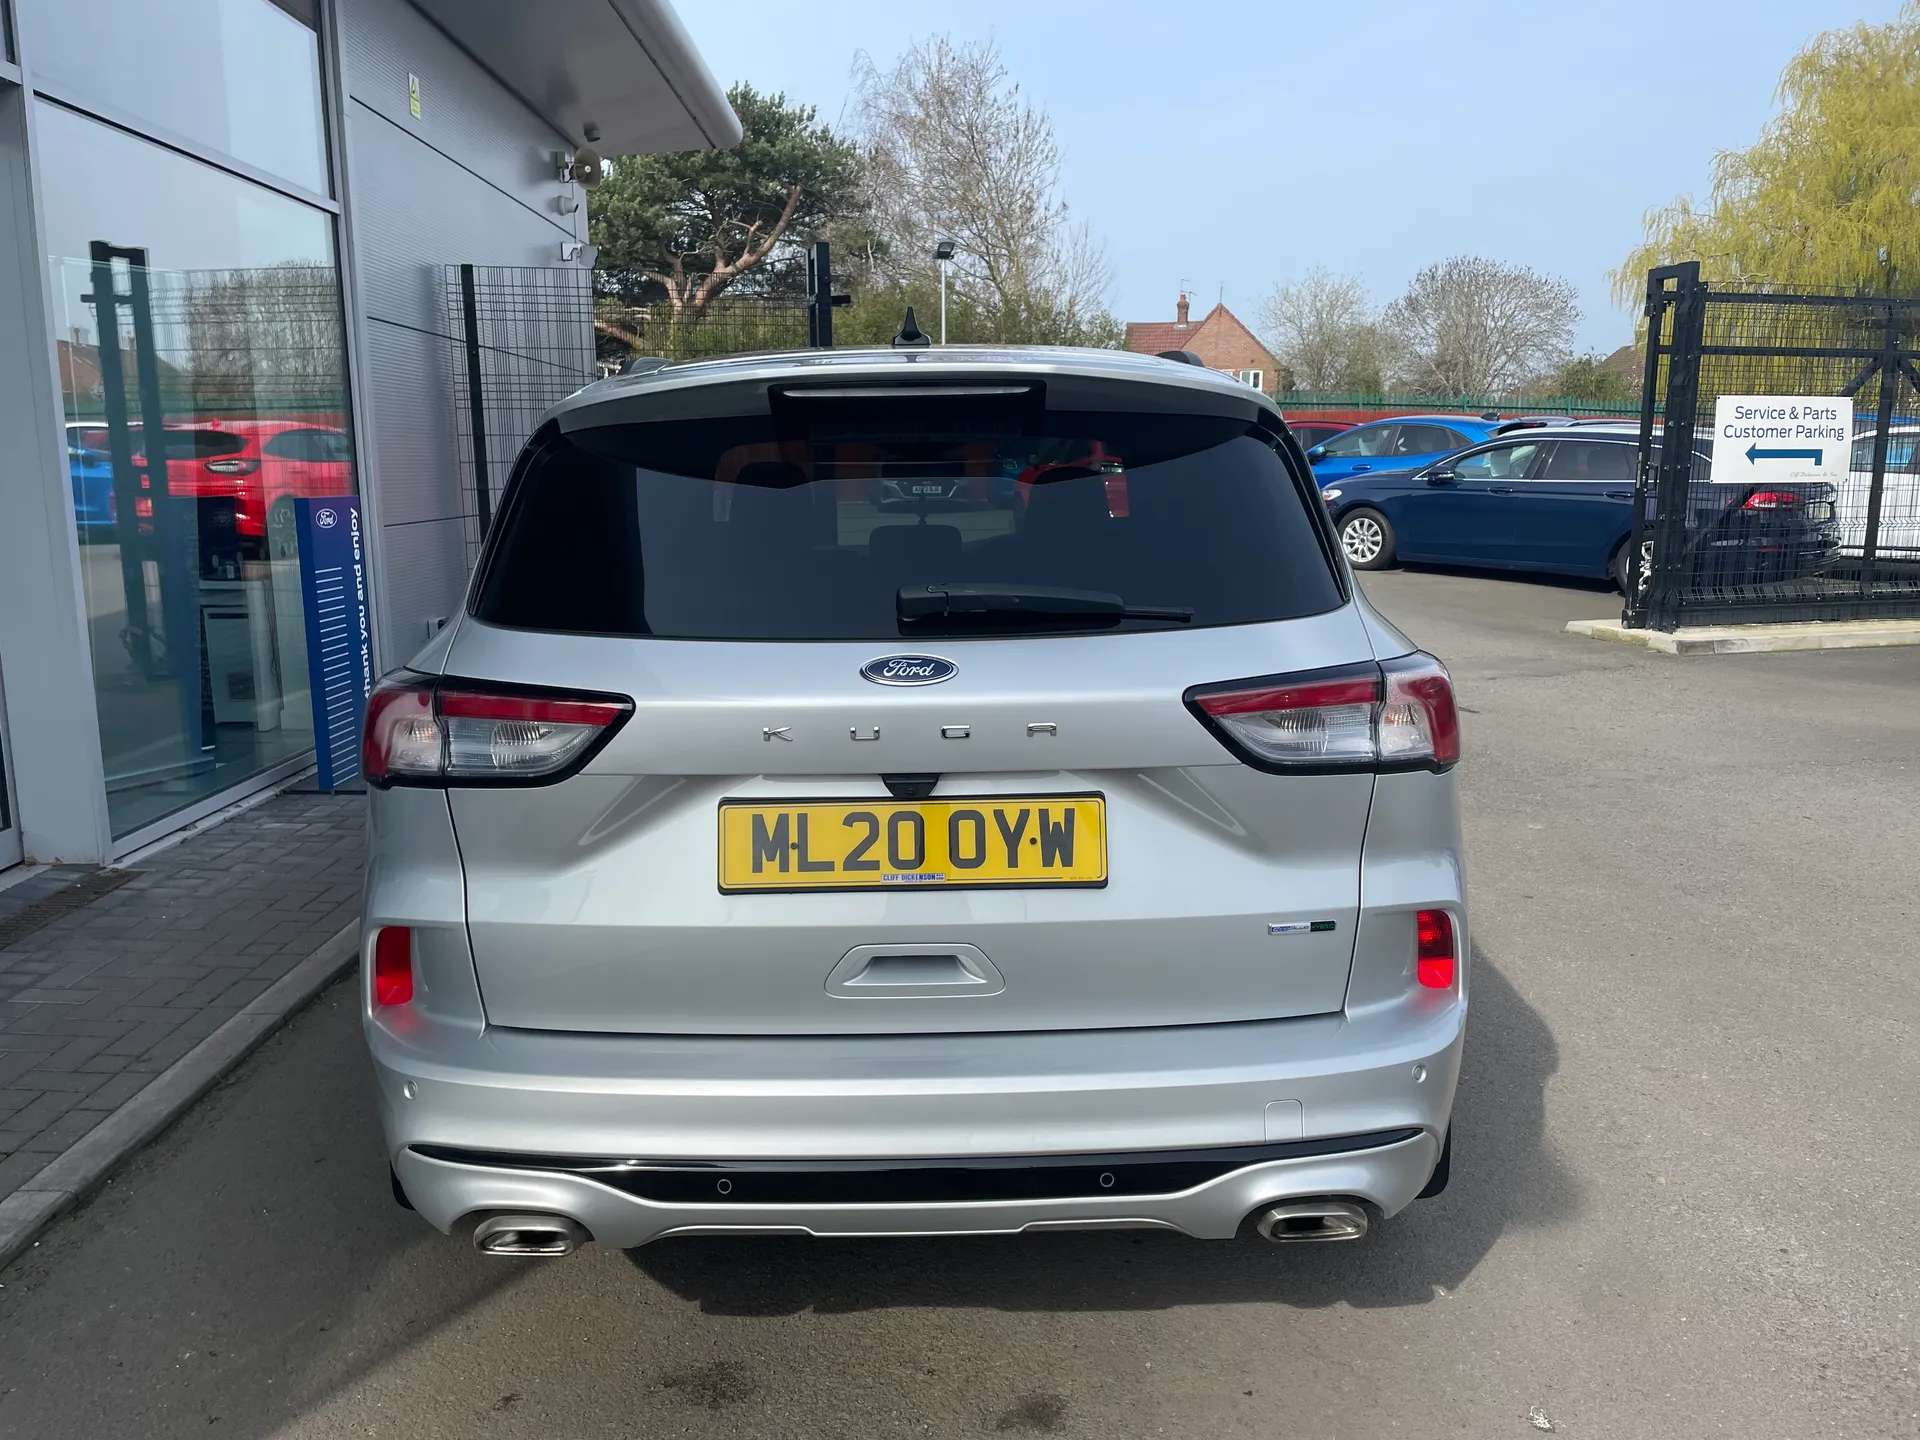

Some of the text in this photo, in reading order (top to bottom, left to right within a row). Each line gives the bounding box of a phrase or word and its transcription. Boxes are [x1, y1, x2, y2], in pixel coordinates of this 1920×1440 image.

[1734, 405, 1837, 420] Service & Parts
[1723, 424, 1845, 441] Customer Parking
[350, 507, 371, 699] thank you and enjoy
[882, 658, 937, 678] Ford
[763, 721, 1058, 742] KUGA
[751, 807, 1076, 873] ML20 OYW
